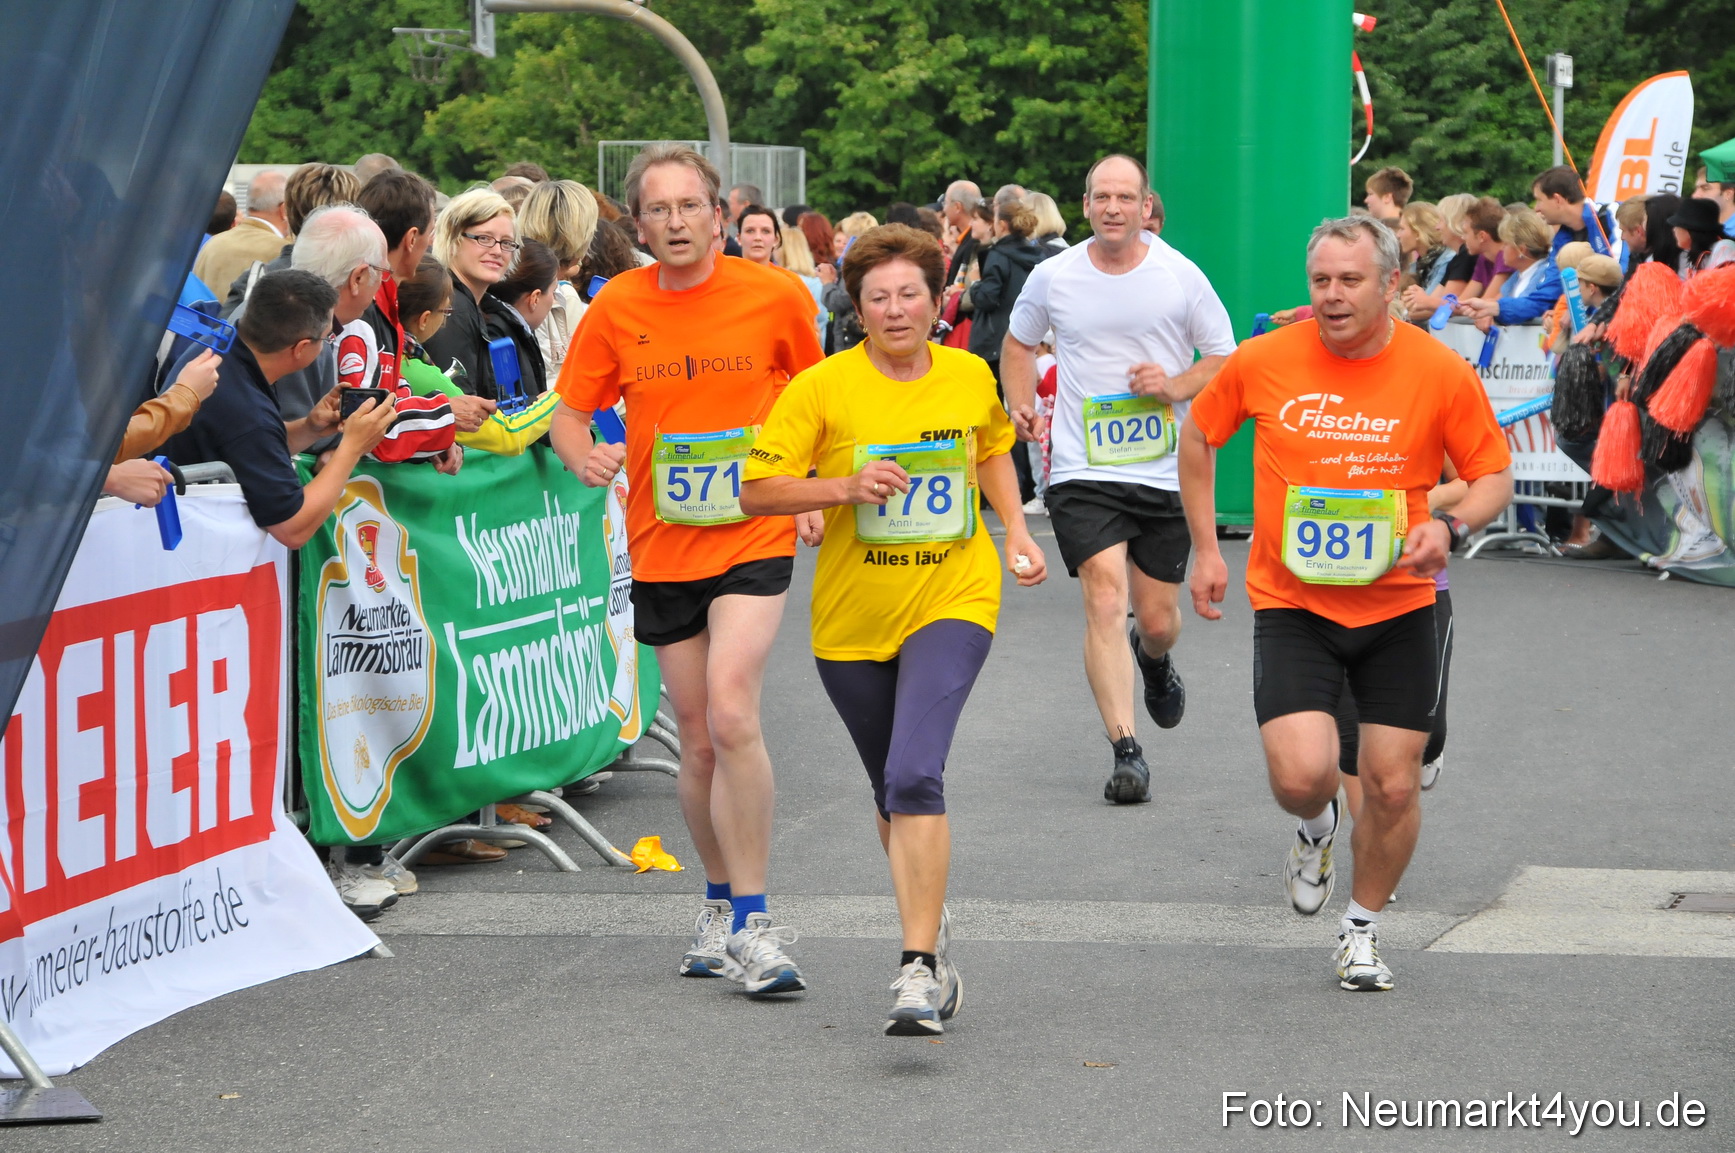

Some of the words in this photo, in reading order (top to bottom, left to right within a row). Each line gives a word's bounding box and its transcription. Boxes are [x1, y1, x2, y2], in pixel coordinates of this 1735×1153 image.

[636, 362, 681, 382] EURO
[701, 355, 753, 374] POLES
[1090, 415, 1162, 446] 1020
[1298, 408, 1400, 432] Fischer
[1306, 430, 1391, 443] AUTOMOBILE
[1108, 446, 1132, 455] Stefan
[1320, 453, 1343, 465] und
[1344, 451, 1366, 463] das
[667, 461, 740, 502] 571
[679, 503, 717, 512] Hendrik
[878, 475, 953, 517] 78
[888, 518, 913, 528] Anni
[455, 490, 581, 609] Neumarkter
[1296, 520, 1374, 560] 981
[863, 549, 910, 566] Alles
[1305, 560, 1333, 570] Erwin
[326, 630, 423, 678] Lammsbräu
[443, 597, 610, 769] Lammsbräu
[408, 693, 425, 711] Bier
